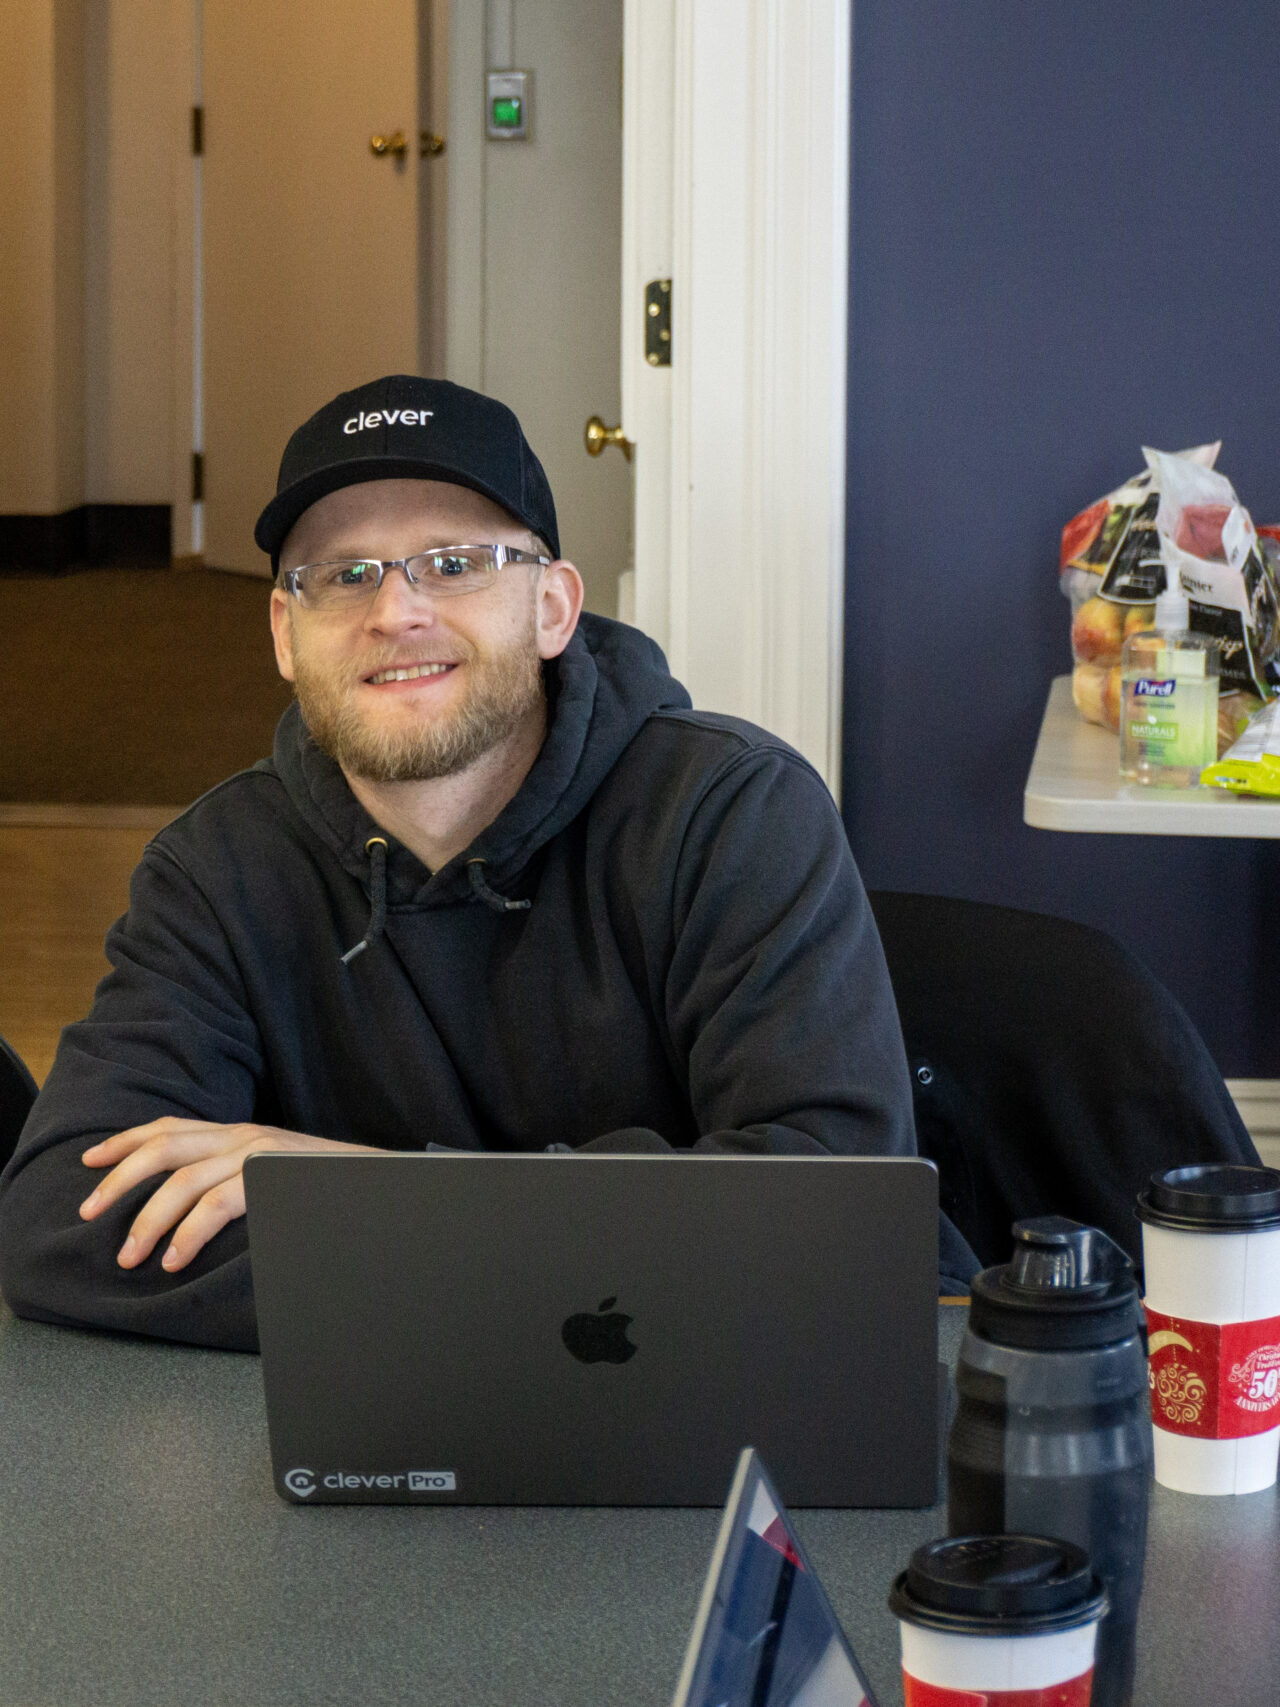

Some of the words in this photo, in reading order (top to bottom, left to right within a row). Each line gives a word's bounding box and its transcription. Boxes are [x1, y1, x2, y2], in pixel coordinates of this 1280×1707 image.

[343, 409, 434, 435] clever
[1132, 725, 1175, 737] NATURALS
[1248, 1369, 1280, 1399] 50
[323, 1472, 405, 1489] clever
